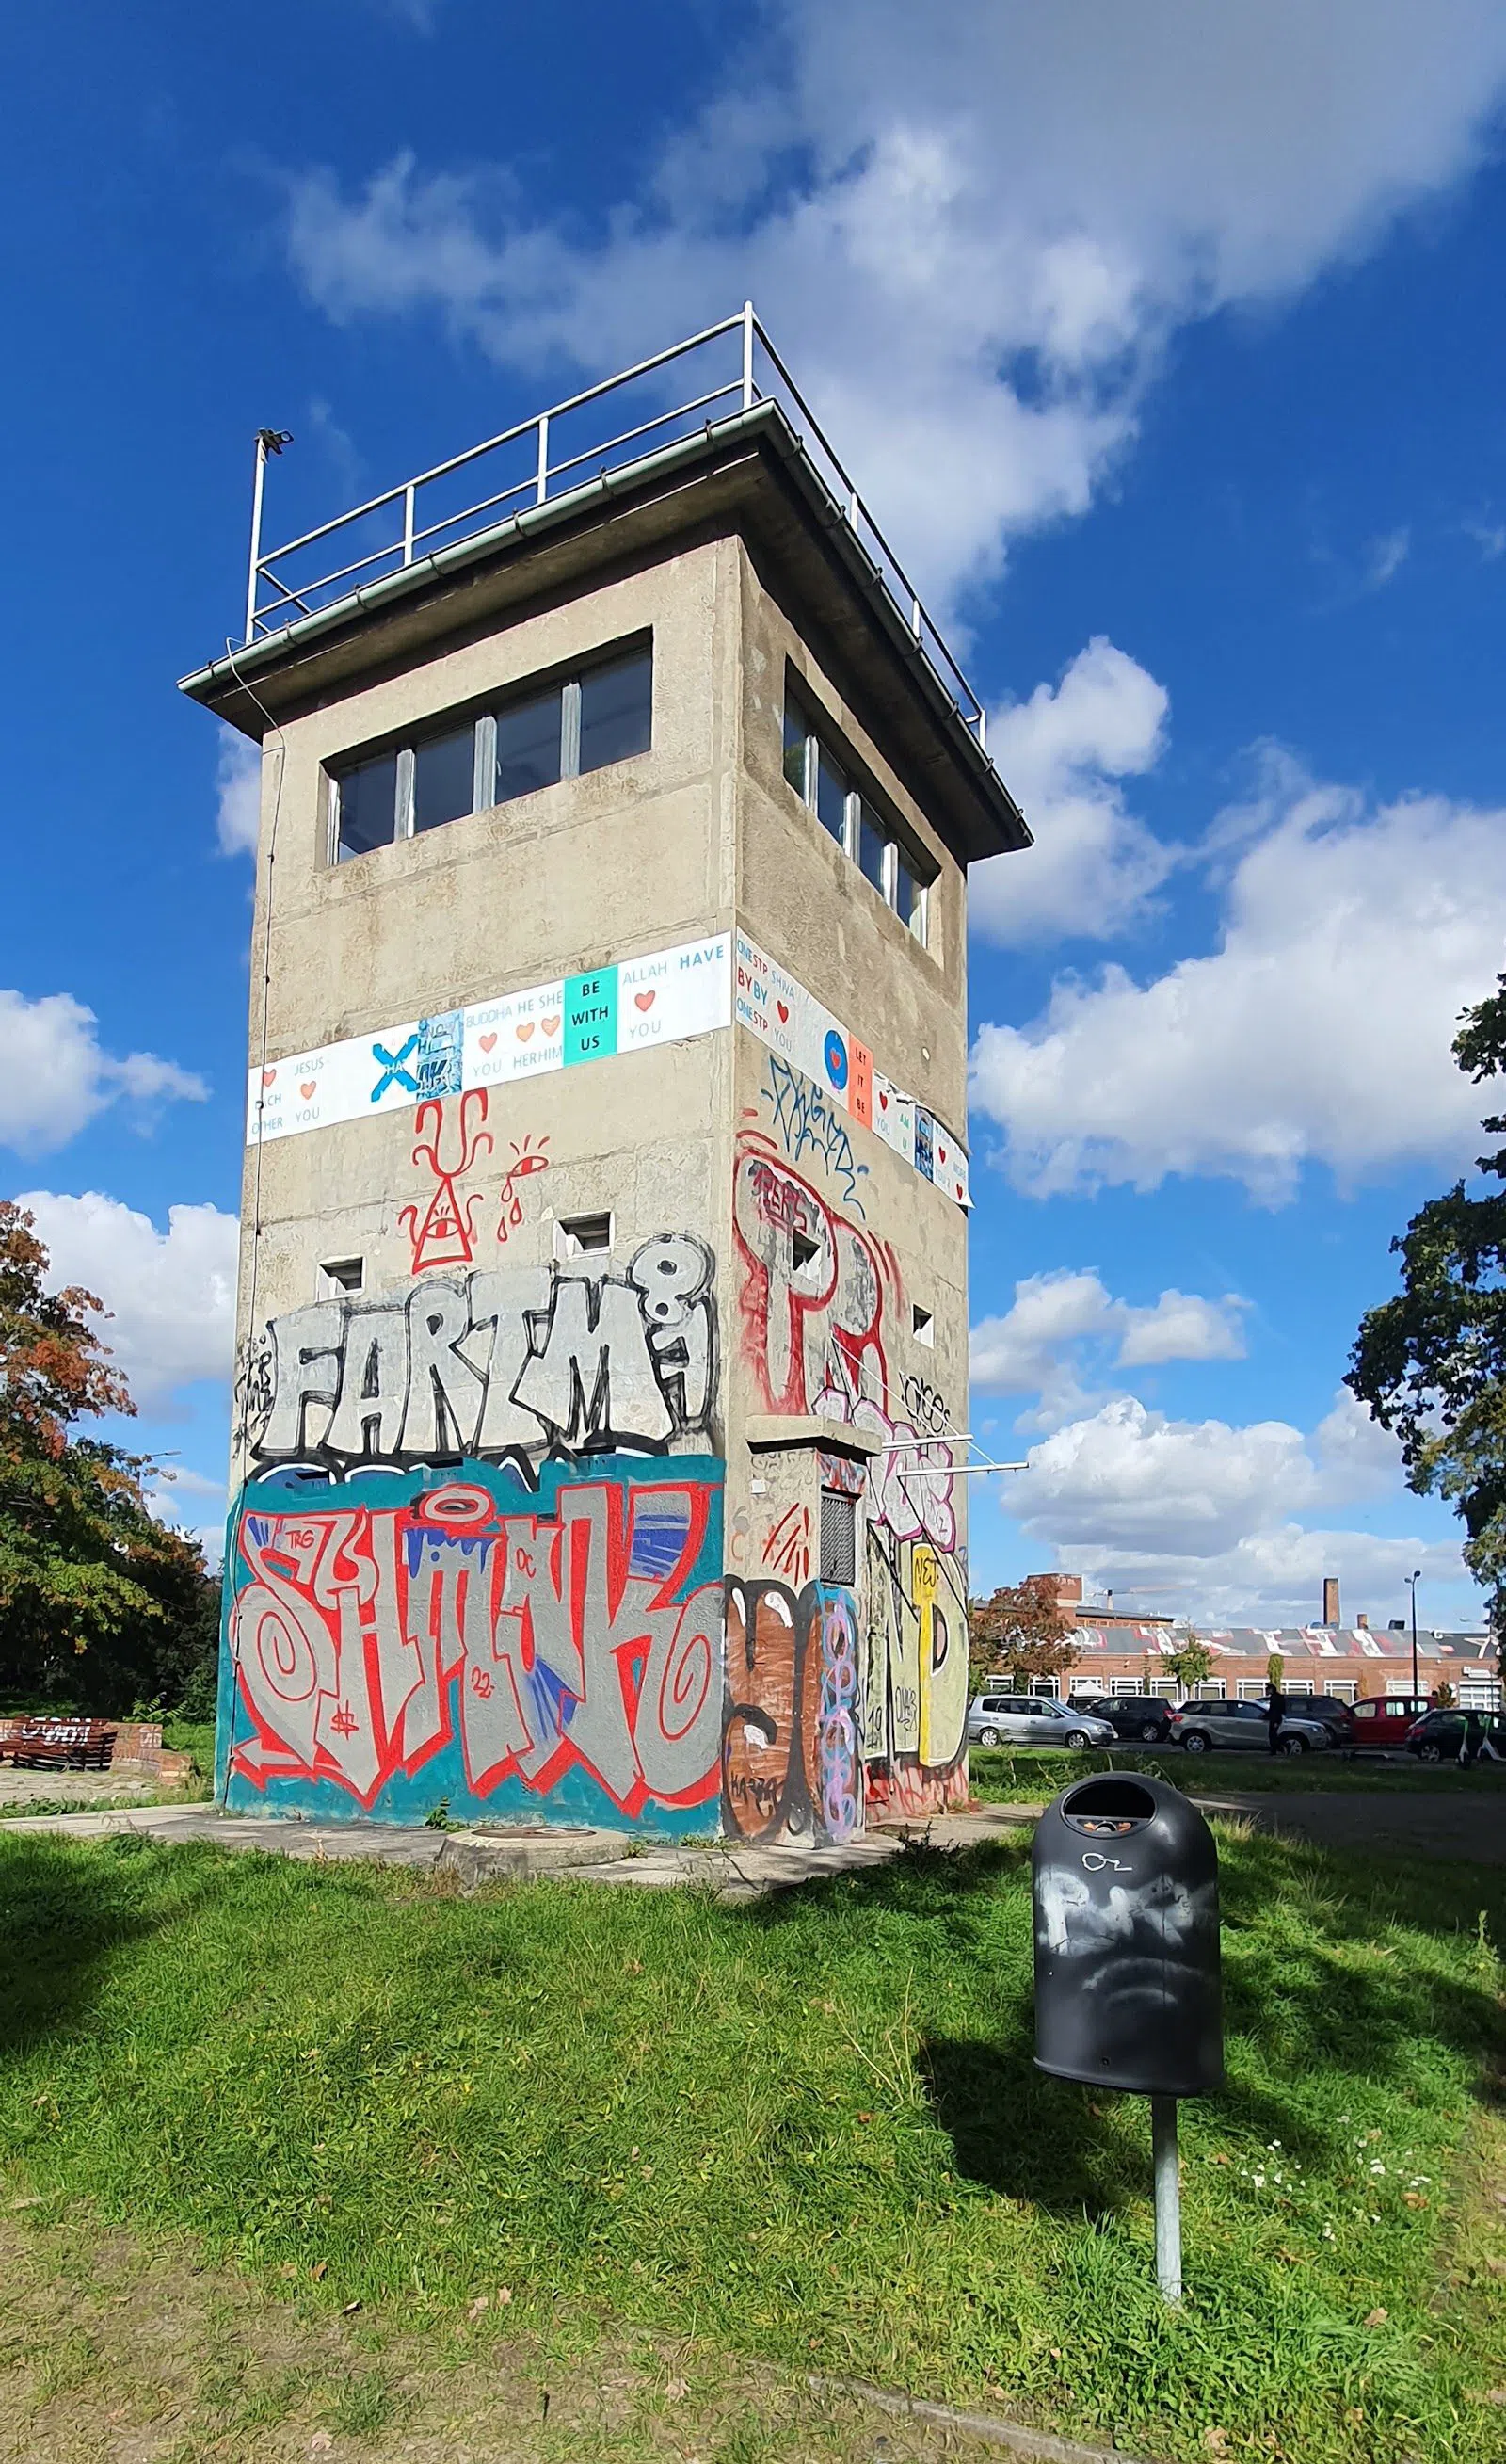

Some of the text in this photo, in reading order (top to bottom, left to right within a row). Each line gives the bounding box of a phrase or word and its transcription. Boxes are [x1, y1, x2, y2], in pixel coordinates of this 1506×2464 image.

[622, 944, 724, 987] ALLAH HAVE
[582, 980, 600, 997] BE
[465, 1005, 513, 1028] BUDDHA
[518, 999, 535, 1014] HE
[572, 1006, 609, 1026] WITH
[630, 1020, 662, 1039] YOU
[581, 1035, 601, 1051] US
[774, 1027, 792, 1053] YOU
[855, 1047, 867, 1066] LET
[294, 1056, 325, 1077] JESUS
[473, 1059, 502, 1077] YOU
[857, 1074, 864, 1088] IT
[296, 1107, 320, 1122] YOU
[857, 1097, 865, 1114] BE
[876, 1116, 890, 1135] YOU
